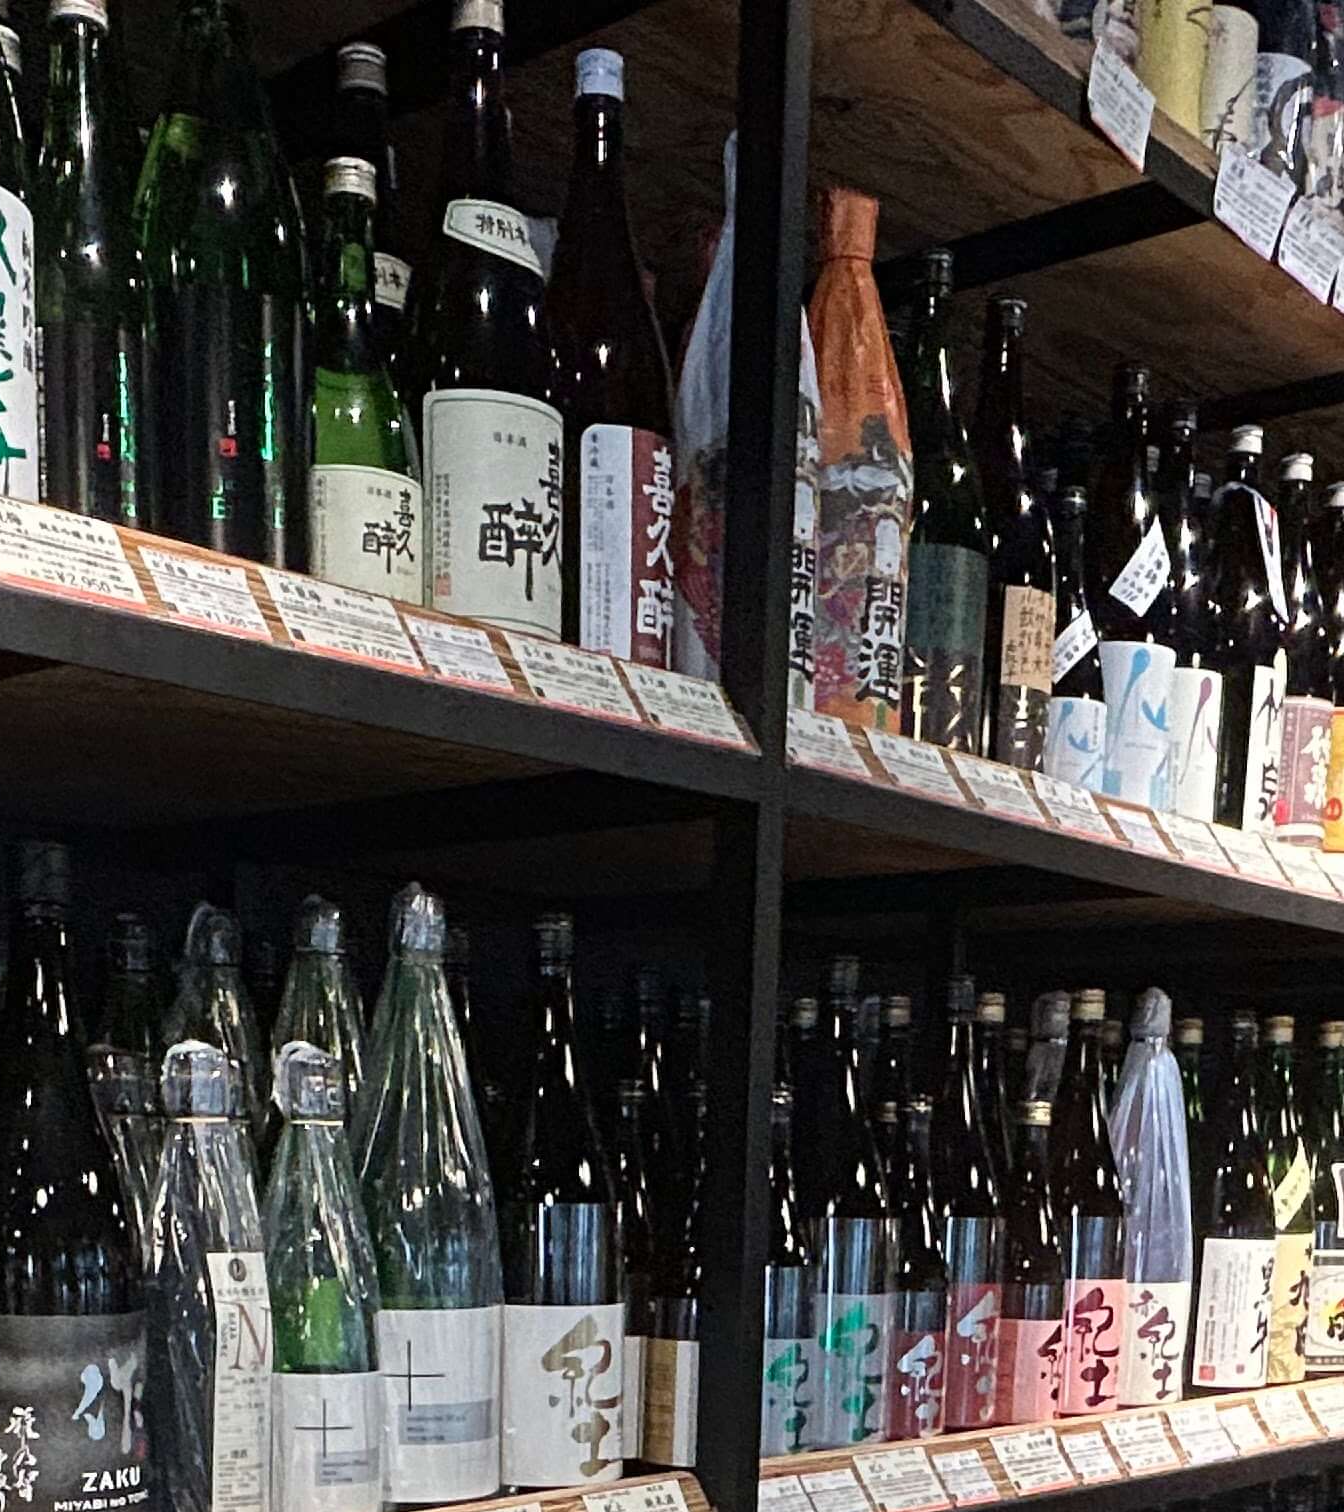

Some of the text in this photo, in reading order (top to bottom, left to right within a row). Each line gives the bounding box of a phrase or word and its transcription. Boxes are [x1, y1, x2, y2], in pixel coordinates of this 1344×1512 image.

[1072, 1286, 1120, 1407] 紀土
[1137, 1306, 1180, 1399] 紀土
[53, 1497, 108, 1512] MIYABI
[81, 1465, 142, 1493] ZAKU
